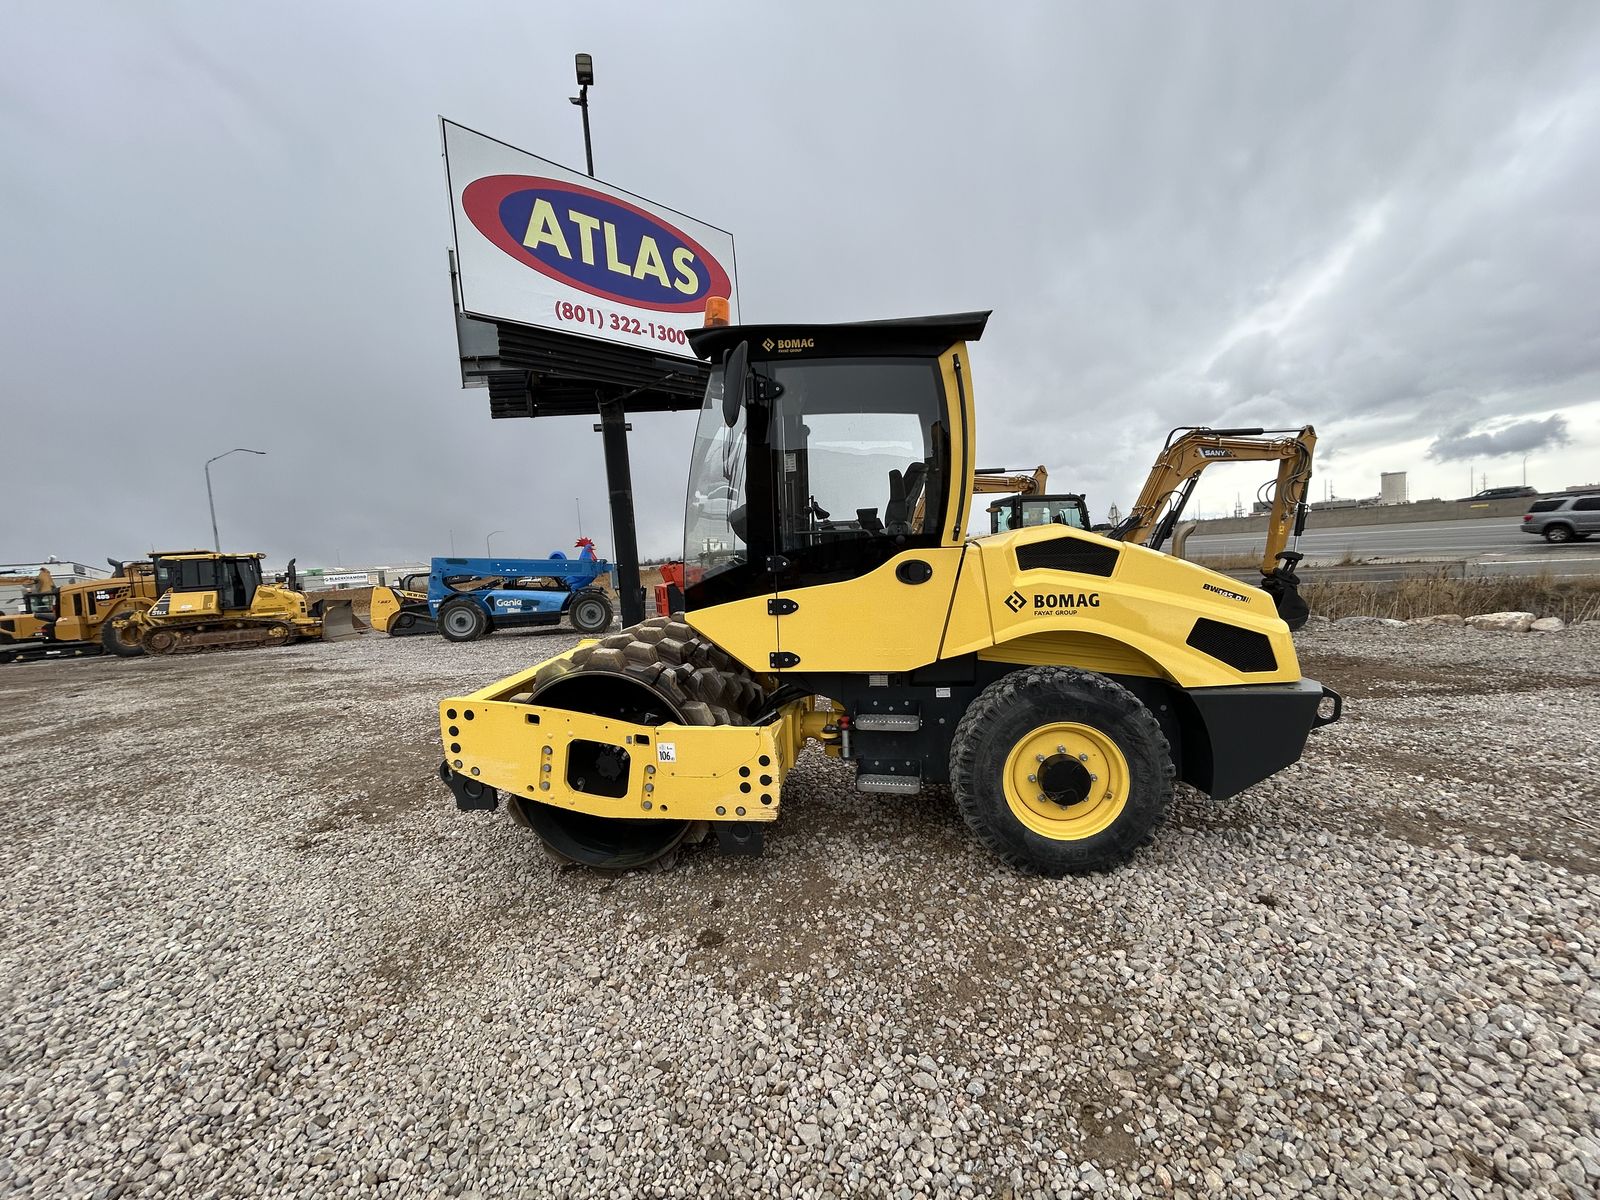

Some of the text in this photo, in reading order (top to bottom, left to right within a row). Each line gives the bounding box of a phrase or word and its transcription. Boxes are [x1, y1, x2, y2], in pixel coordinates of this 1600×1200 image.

[522, 198, 699, 295] ATLAS
[554, 300, 686, 345] (801) 322-1300
[777, 338, 815, 349] BOMAG
[496, 598, 522, 607] Genie
[1033, 593, 1100, 608] BOMAG
[659, 750, 671, 761] 106
